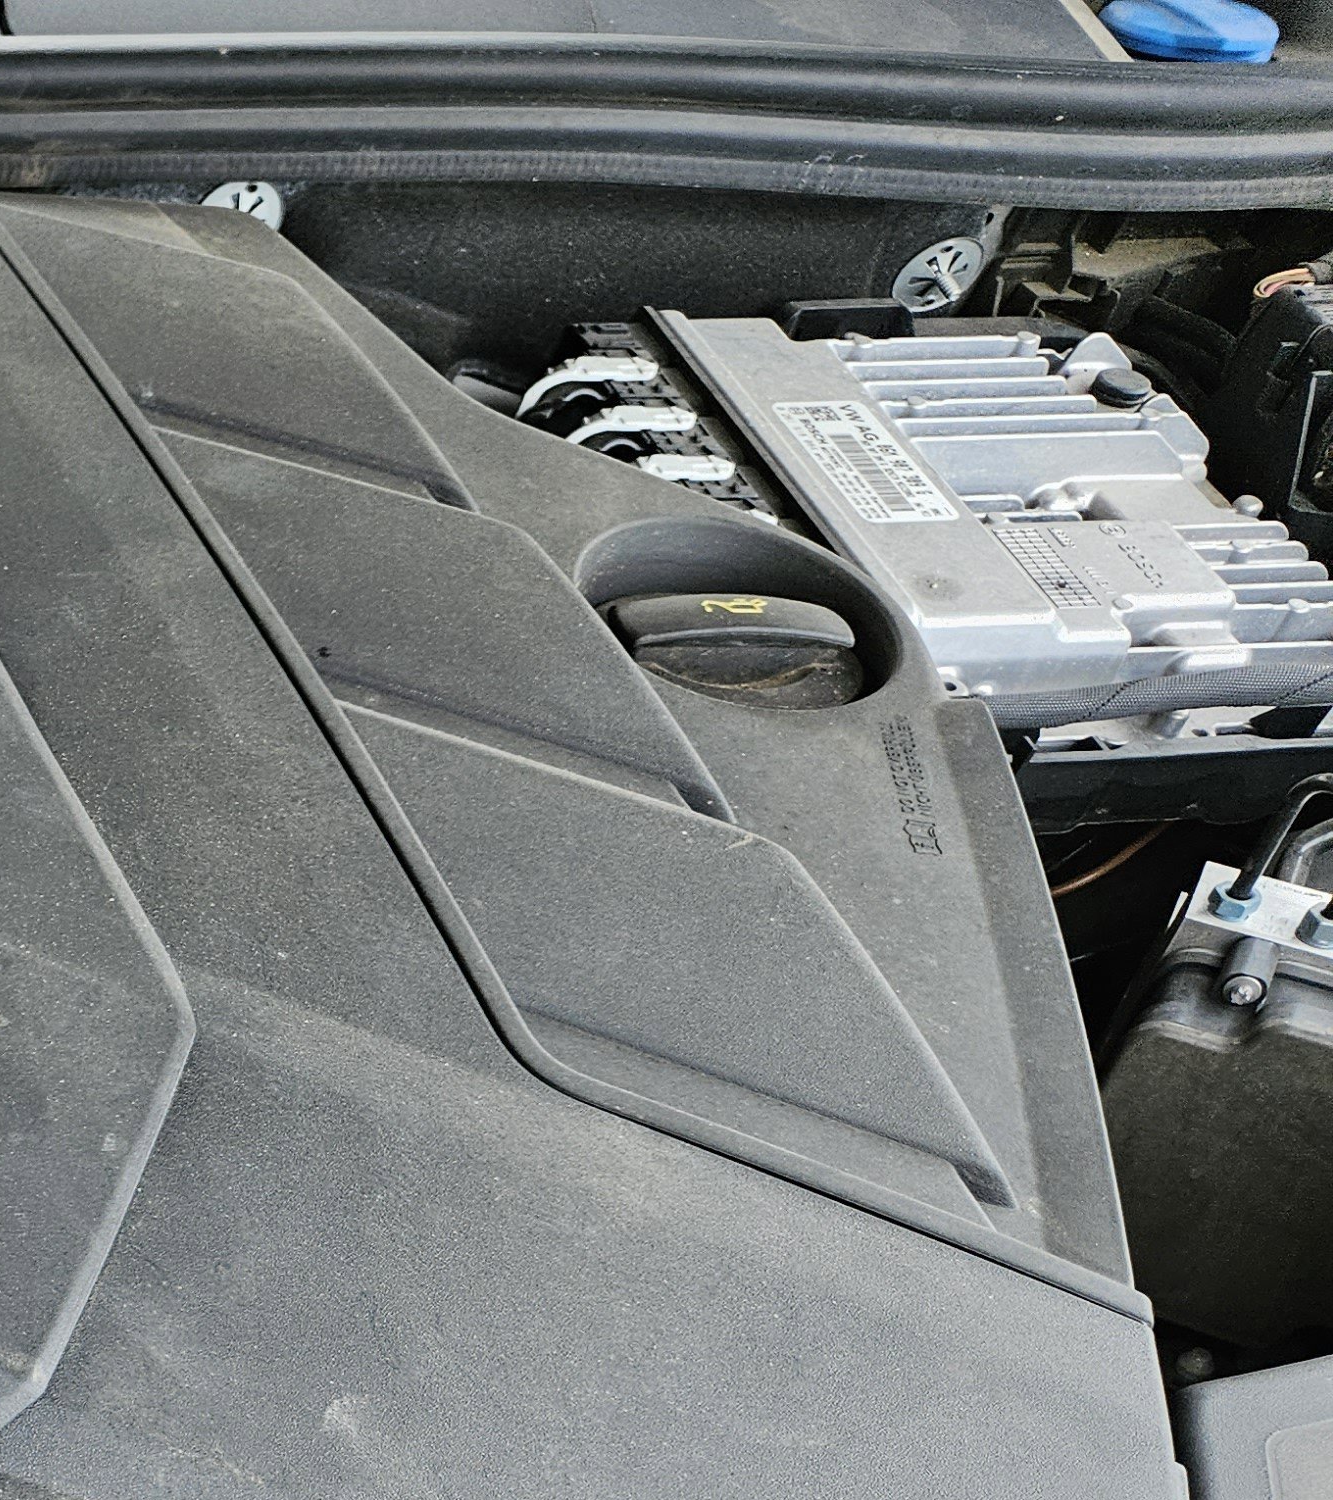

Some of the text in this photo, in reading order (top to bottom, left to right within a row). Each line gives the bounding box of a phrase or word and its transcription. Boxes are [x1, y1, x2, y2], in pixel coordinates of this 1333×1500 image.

[799, 418, 829, 445] BOSCH
[839, 404, 864, 423] VW
[855, 425, 880, 442] AG
